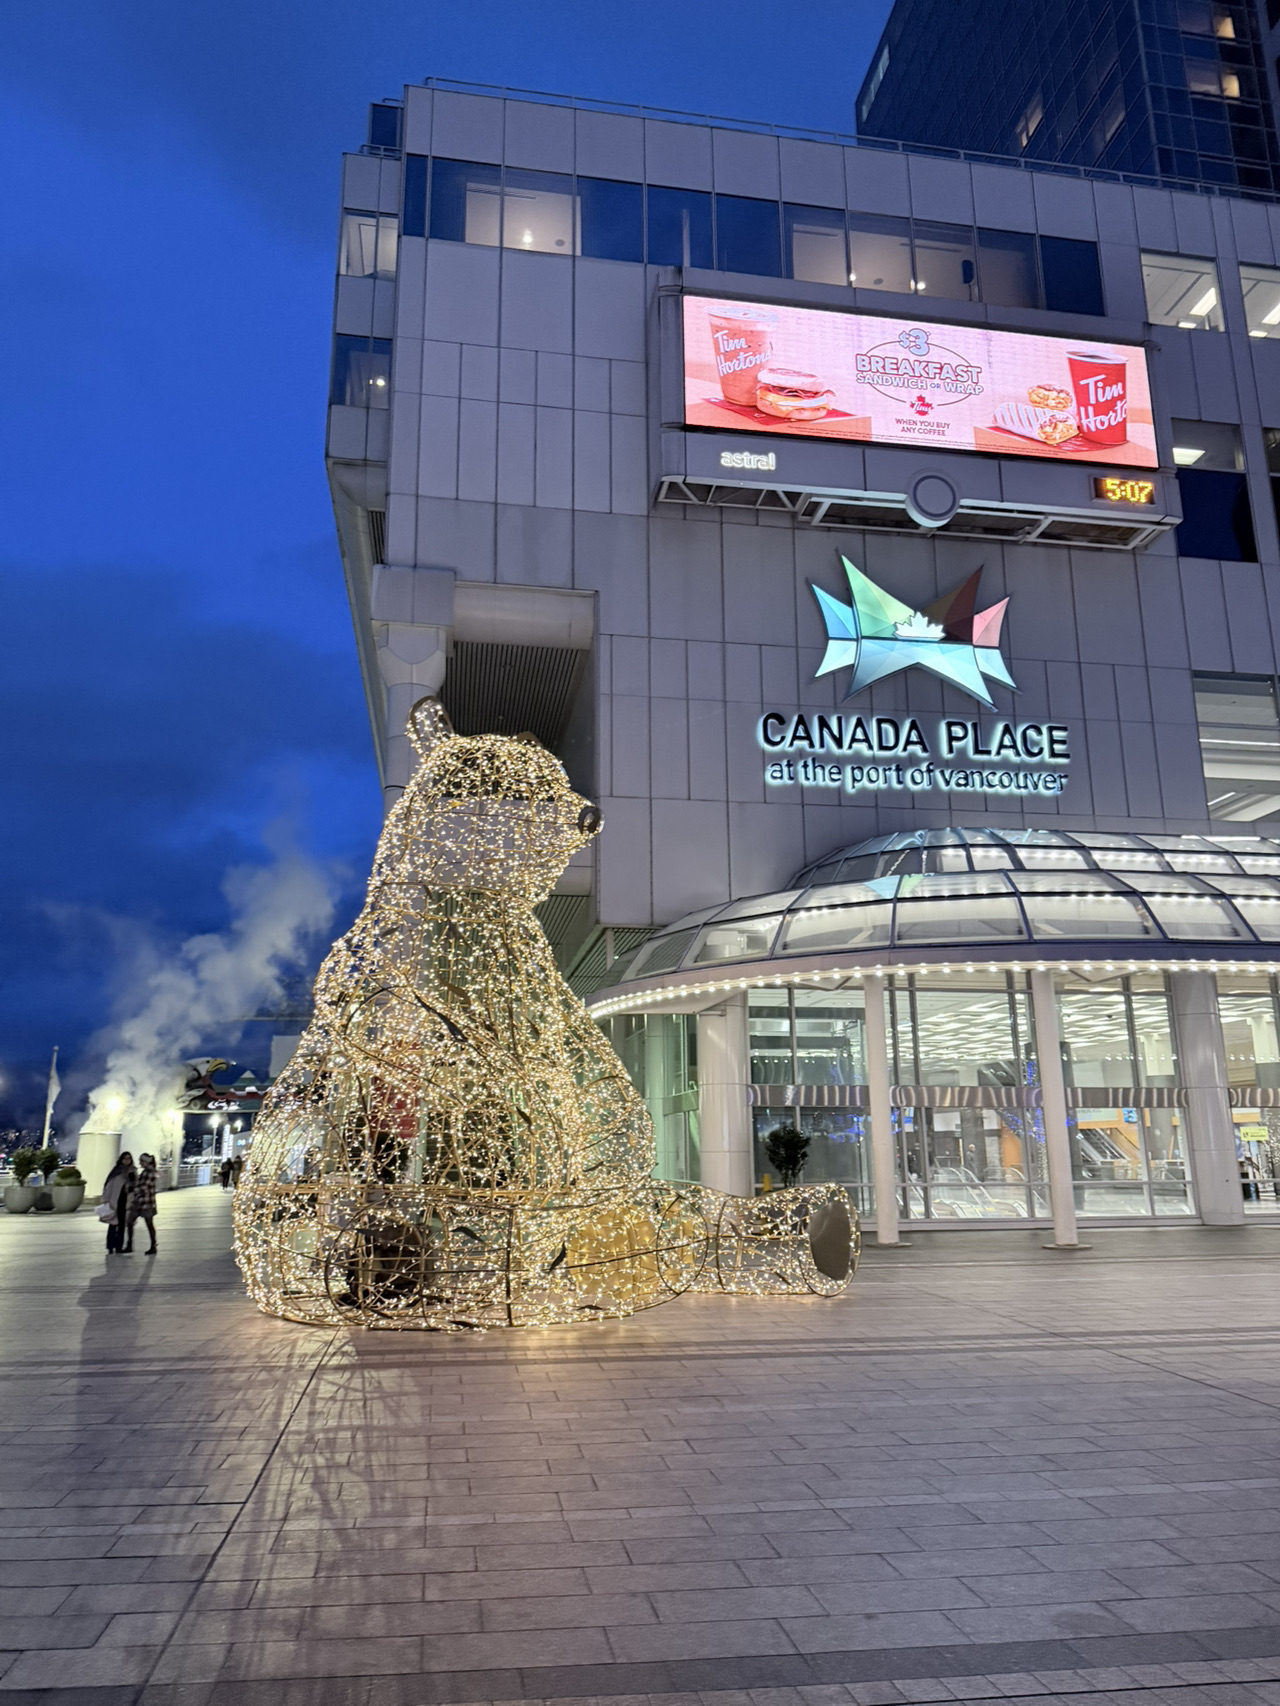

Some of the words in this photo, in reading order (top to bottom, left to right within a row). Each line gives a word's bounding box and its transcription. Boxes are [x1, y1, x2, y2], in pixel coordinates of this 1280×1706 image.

[713, 330, 748, 353] Tim
[716, 350, 770, 377] Hortons
[855, 353, 982, 384] BREAKFAST
[855, 372, 928, 390] SANDWICH
[943, 381, 984, 395] WRAP
[1079, 374, 1124, 404] Tim
[895, 418, 918, 426] WHEN
[919, 420, 935, 428] YOU
[936, 421, 951, 429] BUY
[900, 426, 917, 434] ANY
[917, 427, 946, 437] COFFEE
[720, 451, 776, 471] astral
[1105, 478, 1153, 504] 5:07
[760, 711, 929, 754] CANADA
[944, 720, 1071, 760] PLACE
[768, 759, 795, 782] at
[800, 757, 842, 783] the
[849, 763, 904, 790] port
[910, 762, 935, 787] of
[939, 767, 1069, 793] vancouver
